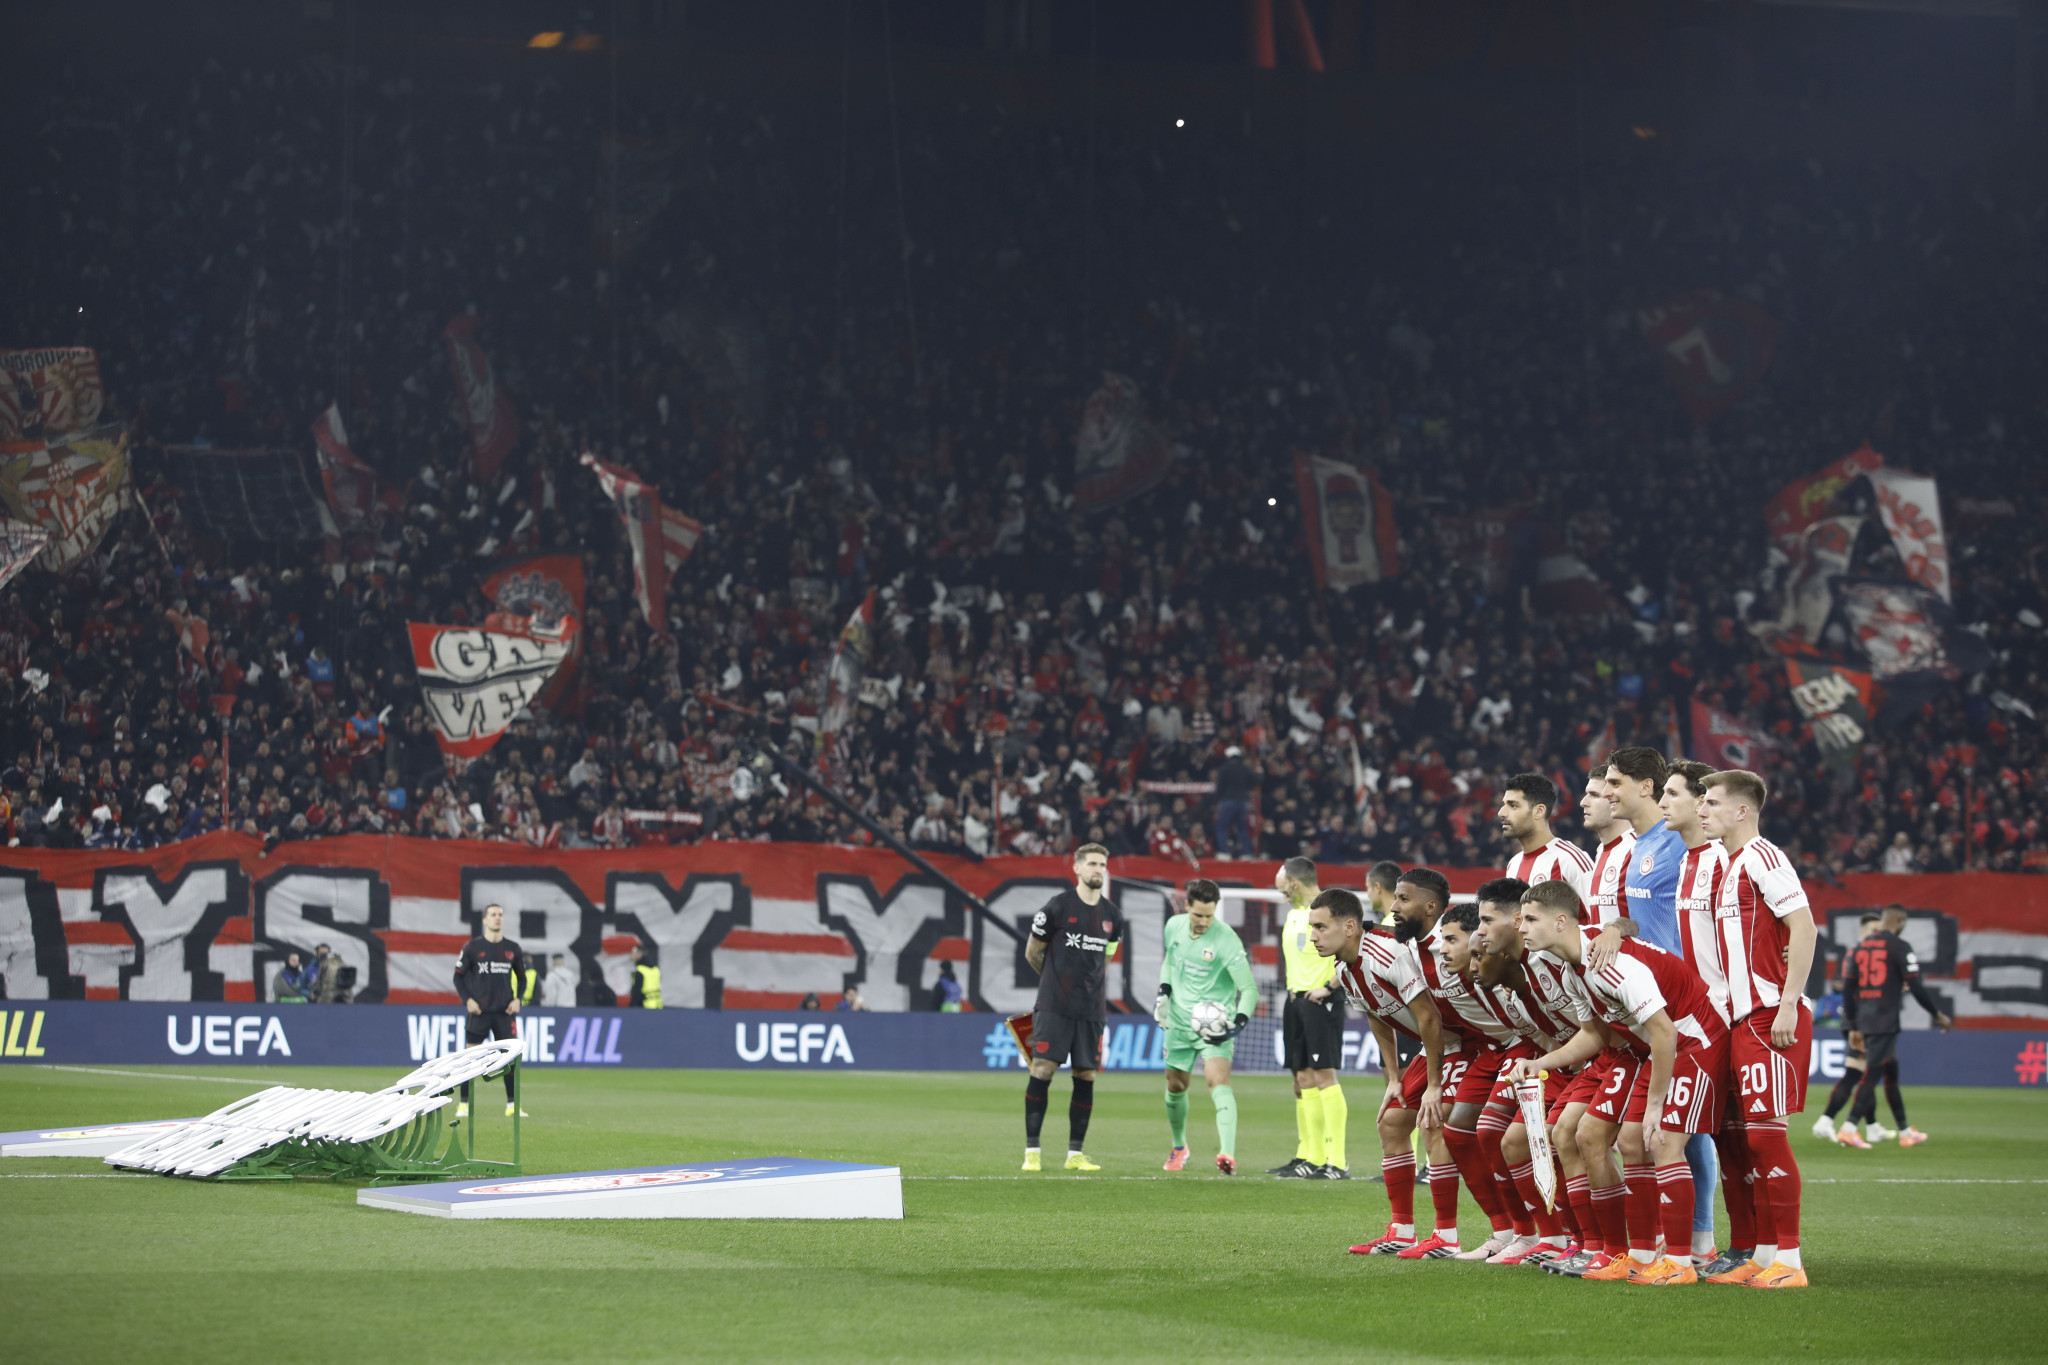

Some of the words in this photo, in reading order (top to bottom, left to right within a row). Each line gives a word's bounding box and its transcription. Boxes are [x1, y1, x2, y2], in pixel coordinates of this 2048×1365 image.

[1855, 949, 1889, 987] 35
[0, 1010, 46, 1057] LL
[166, 1014, 293, 1057] UEFA
[557, 1016, 623, 1063] ALL
[735, 1021, 856, 1064] UEFA
[1604, 1066, 1626, 1095] 3
[1740, 1062, 1768, 1096] 20
